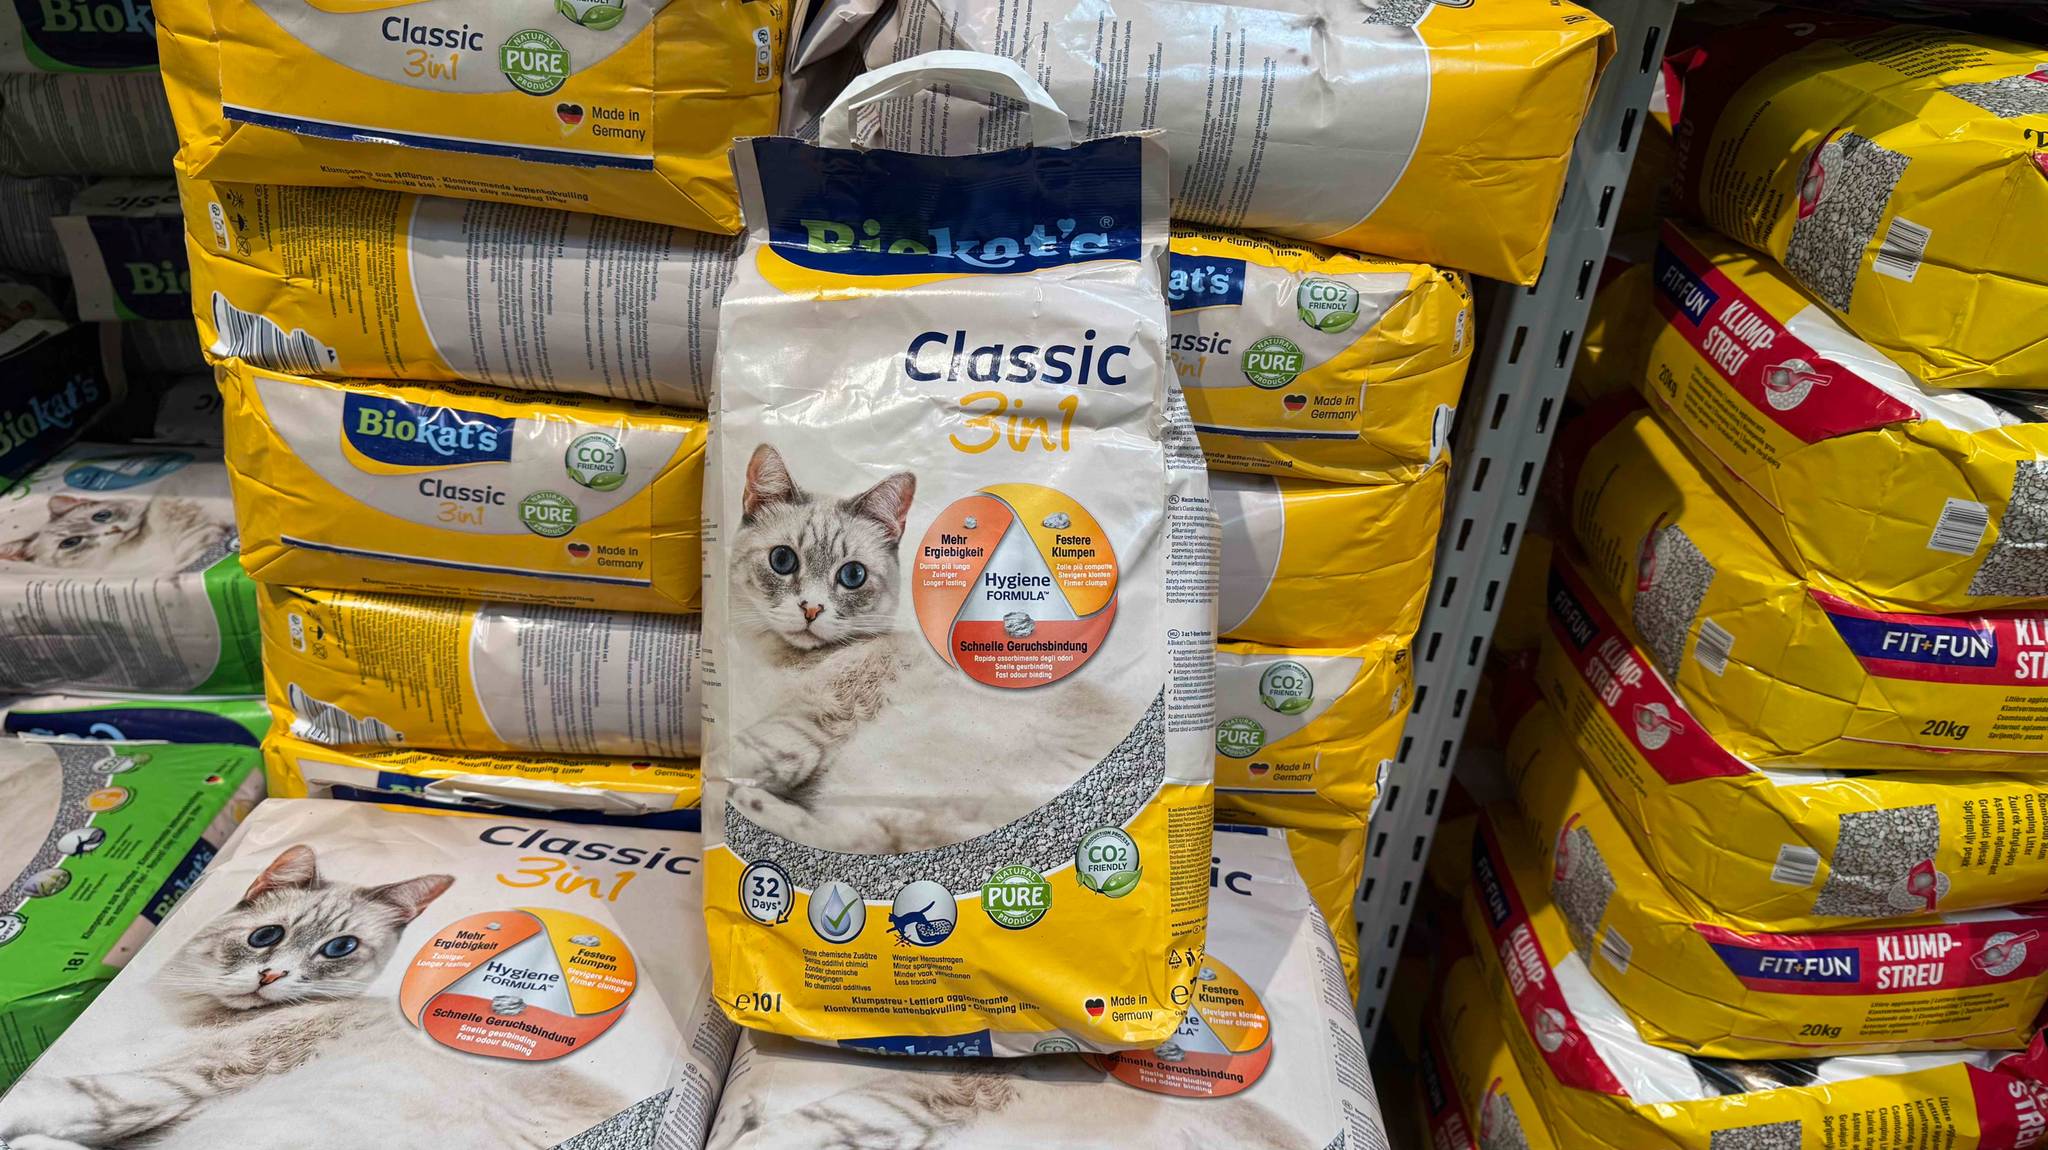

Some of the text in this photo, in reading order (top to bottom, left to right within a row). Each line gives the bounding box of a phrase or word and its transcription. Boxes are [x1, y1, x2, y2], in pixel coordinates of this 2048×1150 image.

[382, 16, 484, 52] Classic
[514, 32, 555, 48] NATURAL
[403, 48, 459, 81] 3in1
[506, 50, 563, 74] PURE
[516, 76, 555, 90] PRODUCT
[592, 106, 640, 121] Made in
[592, 124, 646, 141] Germany
[1309, 286, 1347, 303] CO2
[1308, 302, 1347, 310] FRIENDLY
[1718, 300, 1776, 351] KLUMP-
[1257, 336, 1293, 349] NATURAL
[904, 328, 1131, 386] Classic
[1702, 325, 1749, 376] STREU
[1248, 354, 1296, 372] PURE
[1254, 374, 1288, 387] PRODUCT
[1313, 395, 1355, 406] Made in
[1310, 408, 1358, 421] Germany
[948, 390, 1080, 455] 3in1
[356, 406, 499, 456] Biokat's
[577, 446, 615, 465] CO2
[576, 462, 616, 472] FRIENDLY
[418, 477, 506, 507] Classic
[531, 492, 568, 505] NATURAL
[436, 502, 484, 525] 3in1
[524, 506, 573, 522] PURE
[533, 524, 568, 535] PRODUCT
[941, 534, 968, 545] Mehr
[1055, 534, 1091, 545] Festere
[597, 545, 639, 557] Made in
[924, 547, 984, 559] Ergiebigkeit
[1051, 547, 1096, 559] Klumpen
[597, 557, 644, 570] Germany
[931, 571, 958, 579] Zuiniger
[985, 572, 1051, 590] Hygiene
[923, 579, 967, 588] Longer lasting
[1063, 579, 1084, 587] Firmer
[960, 641, 1088, 653] Schnelle Geruchsbindung
[1882, 630, 1992, 660] FIT+FUN
[995, 663, 1053, 672] Snelle geurbinding
[1598, 635, 1644, 689] KLUMP-
[995, 671, 1052, 680] Fast odour binding
[1585, 656, 1623, 707] STREU
[1270, 676, 1304, 690] CO2
[1269, 689, 1303, 697] FRIENDLY
[1920, 720, 1970, 740] 20kg
[1217, 730, 1260, 745] PURE
[654, 768, 696, 780] Germany
[1275, 763, 1311, 771] Made in
[1273, 773, 1313, 782] Germany
[1084, 830, 1131, 850] PRODUCTION PROCESS
[479, 825, 699, 875] Classic
[1088, 845, 1127, 863] CO2
[1088, 862, 1128, 872] FRIENDLY
[496, 856, 636, 902] 3in1
[996, 867, 1036, 882] NATURAL
[752, 877, 780, 898] 32
[988, 886, 1044, 907] PURE
[998, 913, 1036, 926] PRODUCT
[456, 931, 486, 940] Mehr
[433, 939, 498, 951] Ergiebigkeit
[1877, 932, 1962, 962] KLUMP-
[578, 948, 617, 962] Festere
[818, 951, 878, 960] chemische Zusätze
[892, 954, 919, 963] Weniger
[1509, 923, 1547, 990] KLUMP-
[62, 955, 84, 973] 18
[569, 956, 618, 972] Klumpen
[821, 959, 868, 969] additivi chimici
[893, 962, 912, 970] Minor
[1758, 956, 1851, 977] FIT+FUN
[487, 961, 560, 982] Hygiene
[824, 969, 858, 977] chemische
[893, 970, 916, 978] Minder
[1877, 963, 1943, 990] STREU
[813, 981, 872, 992] chemical additives
[894, 977, 937, 986] Less tracking
[1202, 984, 1239, 996] Festere
[851, 996, 903, 1008] Klumpstreu
[909, 996, 944, 1006] Lettiera
[1110, 995, 1148, 1007] Made in
[1198, 993, 1245, 1007] Klumpen
[824, 1004, 967, 1016] Klontvormende kattenbakvulling
[1111, 1011, 1153, 1023] Germany
[432, 1008, 577, 1046] Schnelle Geruchsbindung
[1799, 1023, 1842, 1038] 20kg
[459, 1024, 537, 1048] Snelle geurbinding
[502, 1038, 533, 1057] binding
[1156, 1062, 1245, 1083] Geruchsbindung
